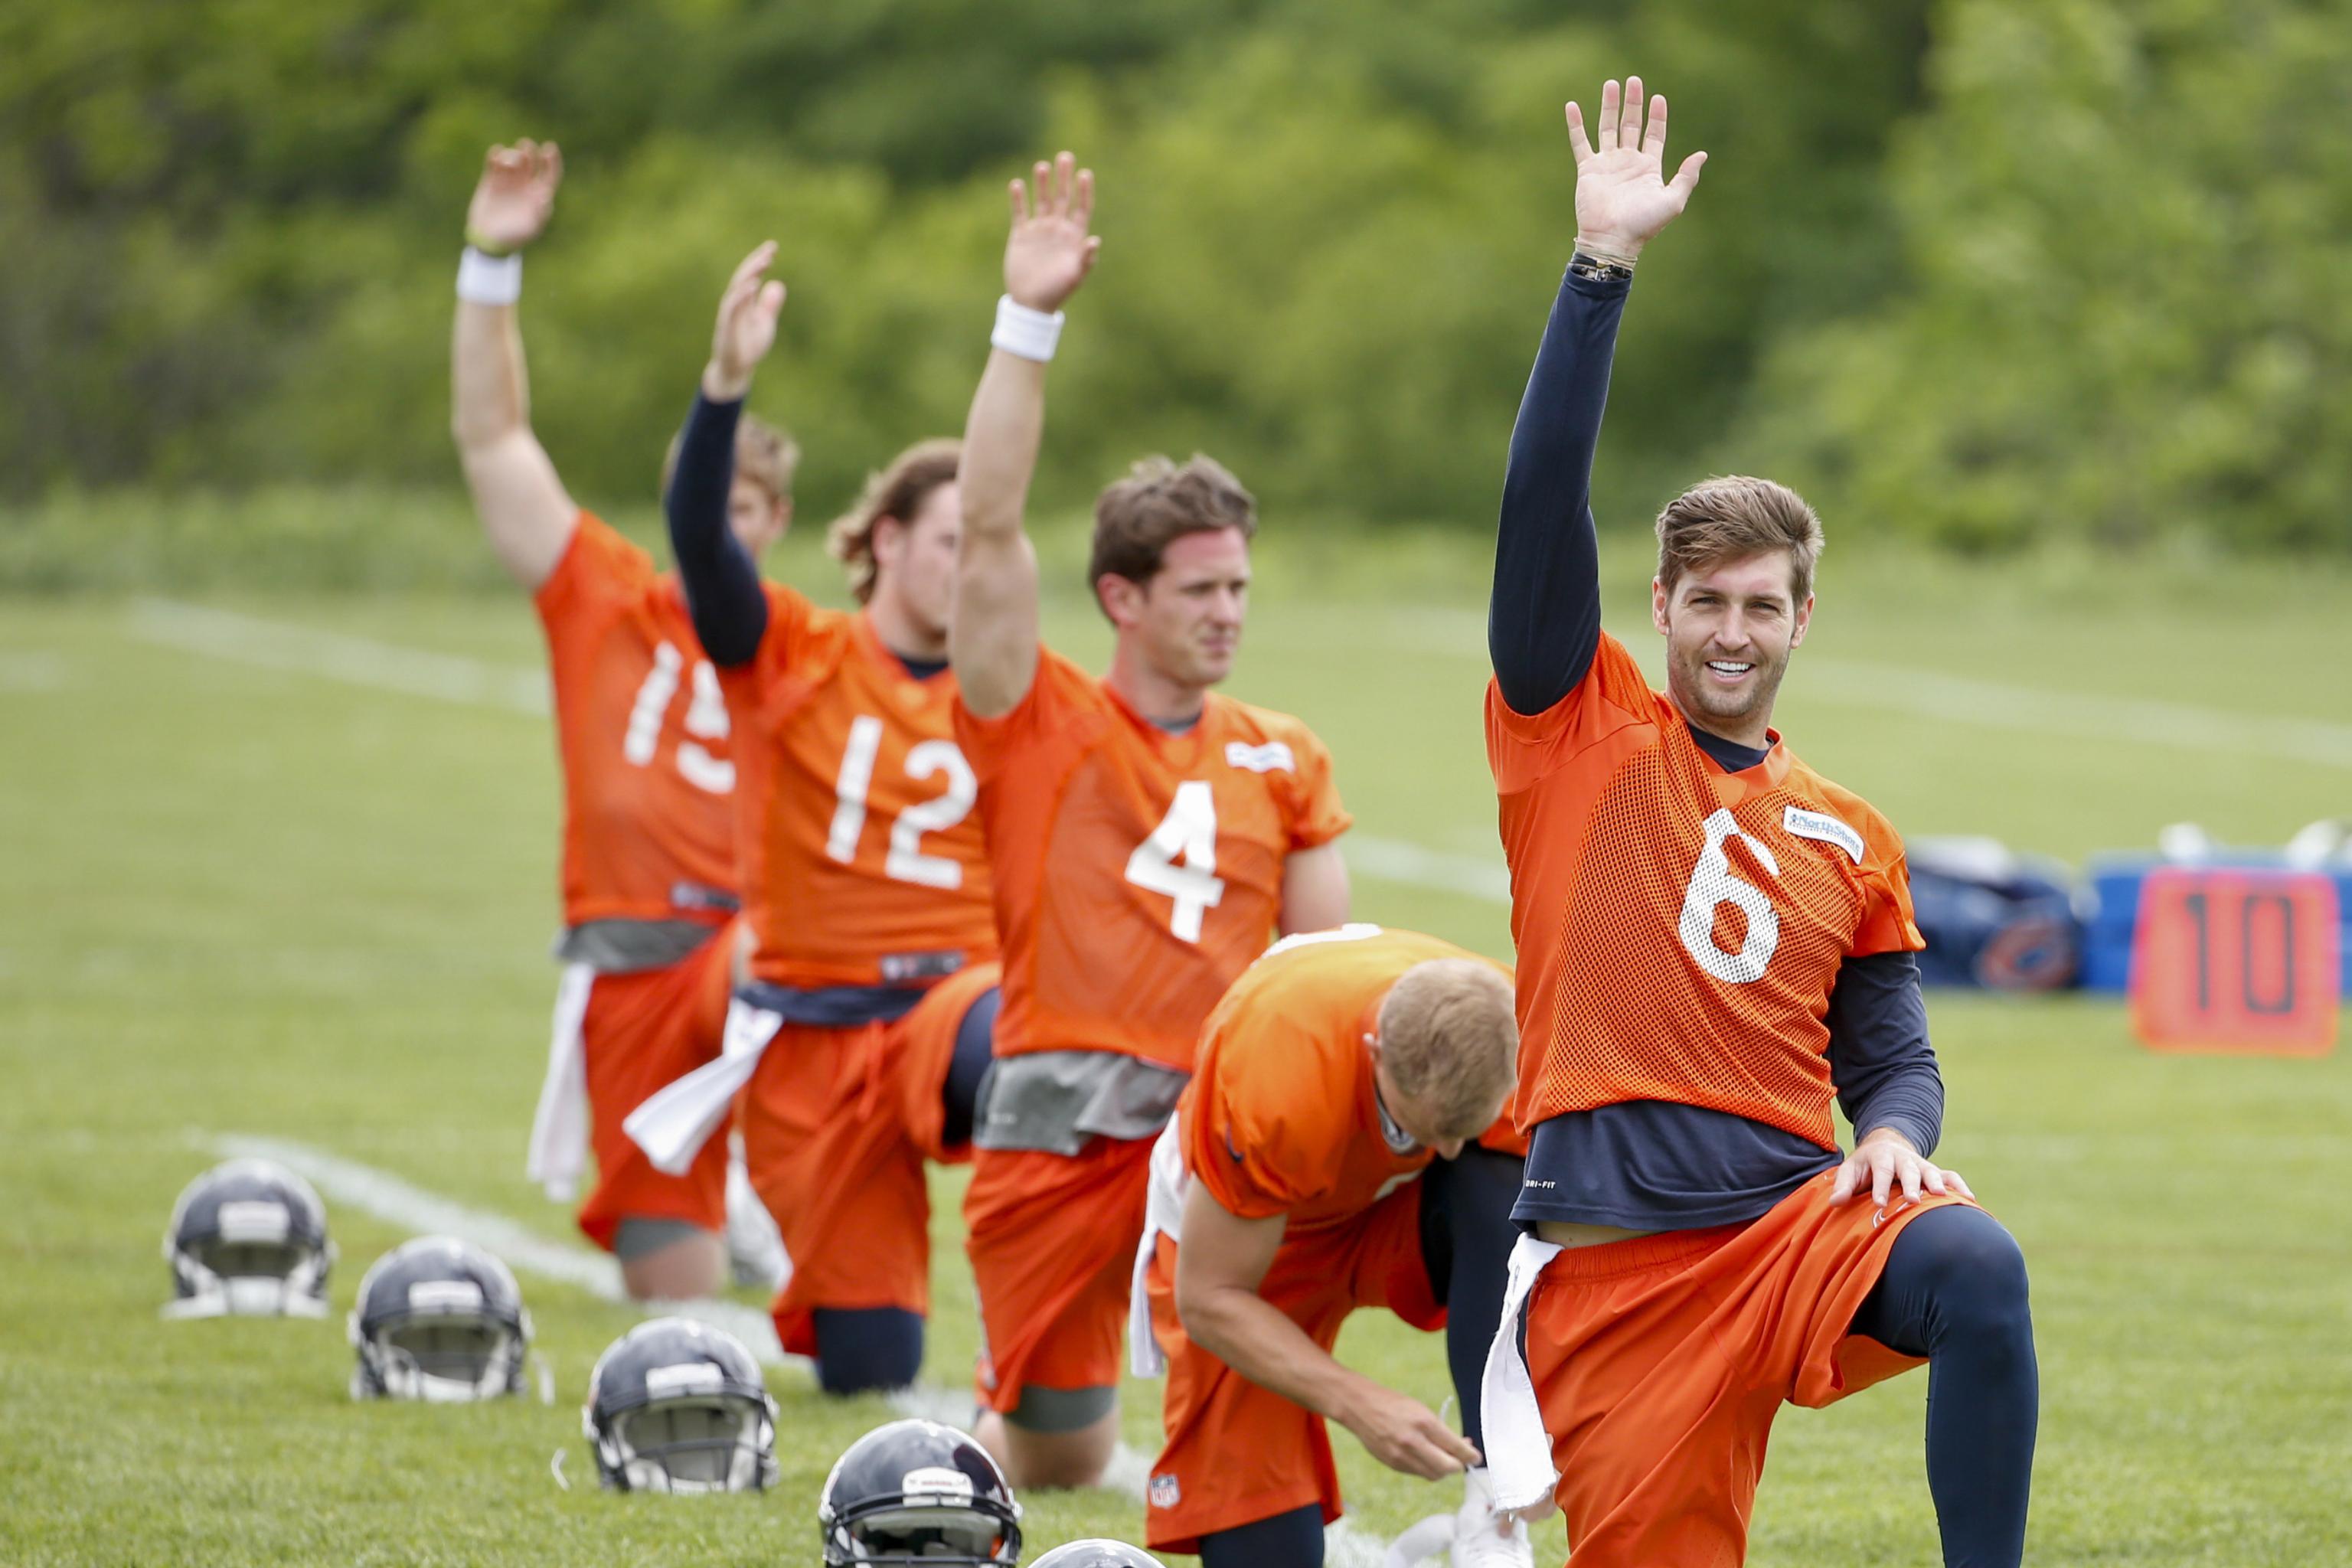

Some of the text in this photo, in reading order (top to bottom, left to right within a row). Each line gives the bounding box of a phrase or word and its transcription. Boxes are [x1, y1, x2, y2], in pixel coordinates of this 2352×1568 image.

[825, 715, 978, 889] 12
[1125, 780, 1225, 944] 4
[1678, 808, 1780, 984] 6
[2186, 893, 2293, 1014] 10
[1525, 1180, 1557, 1189] DRI-FIT
